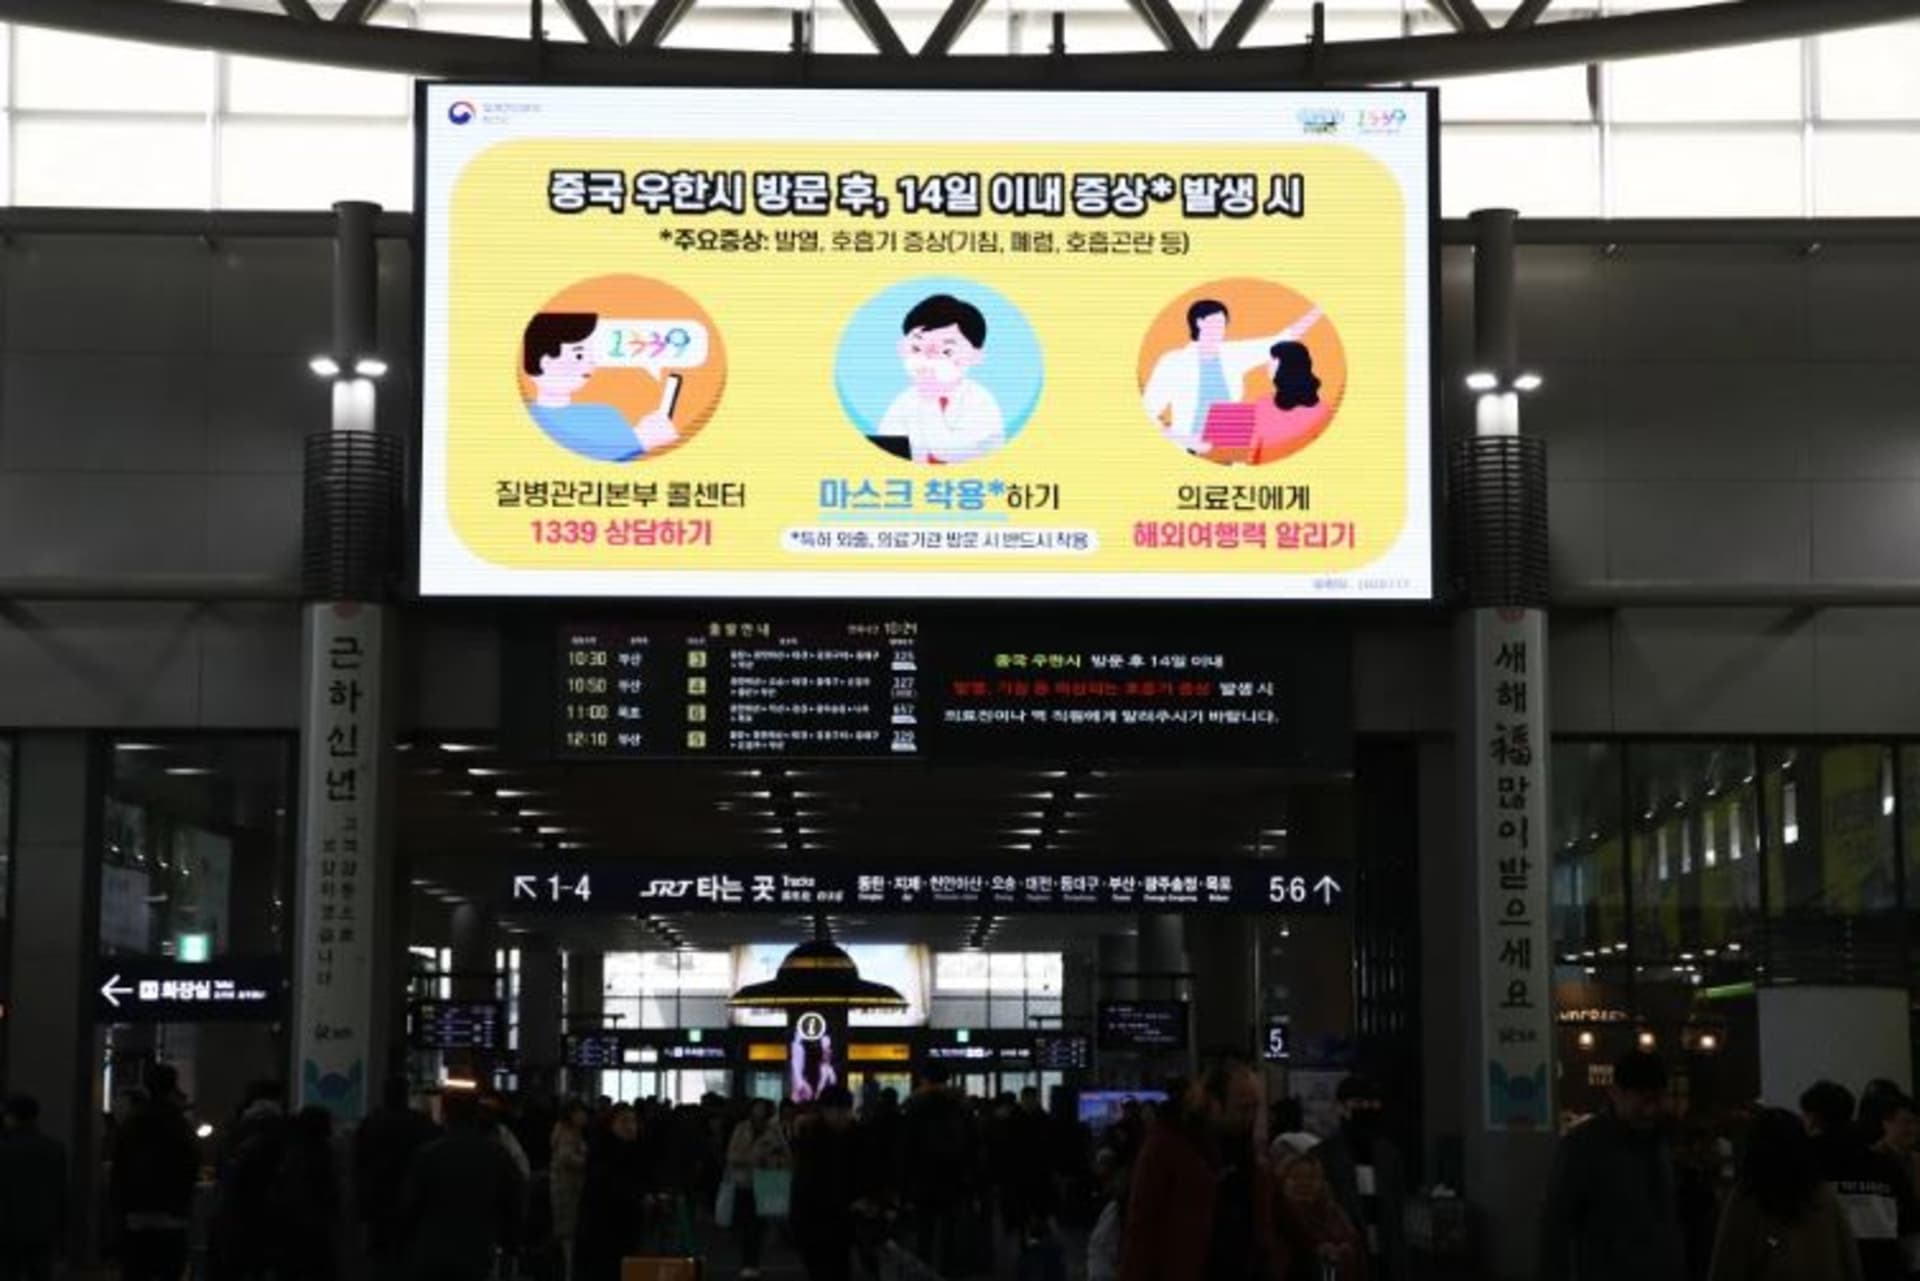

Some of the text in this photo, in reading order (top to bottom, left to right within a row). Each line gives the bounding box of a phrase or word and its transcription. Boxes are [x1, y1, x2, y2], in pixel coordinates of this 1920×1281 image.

[550, 169, 625, 213] 중국
[633, 169, 746, 214] 우한시
[754, 171, 830, 215] 방문
[837, 172, 891, 219] 후,
[896, 172, 981, 218] 14일
[989, 172, 1066, 218] 이내
[1181, 174, 1258, 220] 발생
[1263, 174, 1306, 220] 시
[832, 229, 896, 254] 호흡기
[1067, 231, 1155, 255] 호흡곤란
[1160, 231, 1190, 256] 등)
[496, 479, 746, 508] 질병관리본부 콜센터
[820, 479, 914, 510] 마스크
[1177, 484, 1311, 512] 의료진에게
[531, 519, 713, 547] 1339 상담하기
[1133, 520, 1355, 551] 해외여행력 알리기
[994, 653, 1028, 669] 중국
[1150, 653, 1187, 669] 14일
[1191, 653, 1225, 669] 이내
[327, 635, 364, 802] 근하신년
[547, 873, 592, 903] 1-4
[639, 878, 695, 898] SRT
[696, 873, 745, 903] 타는
[751, 873, 777, 903] 곳
[161, 979, 211, 1000] 화장실
[1269, 1027, 1283, 1053] 5
